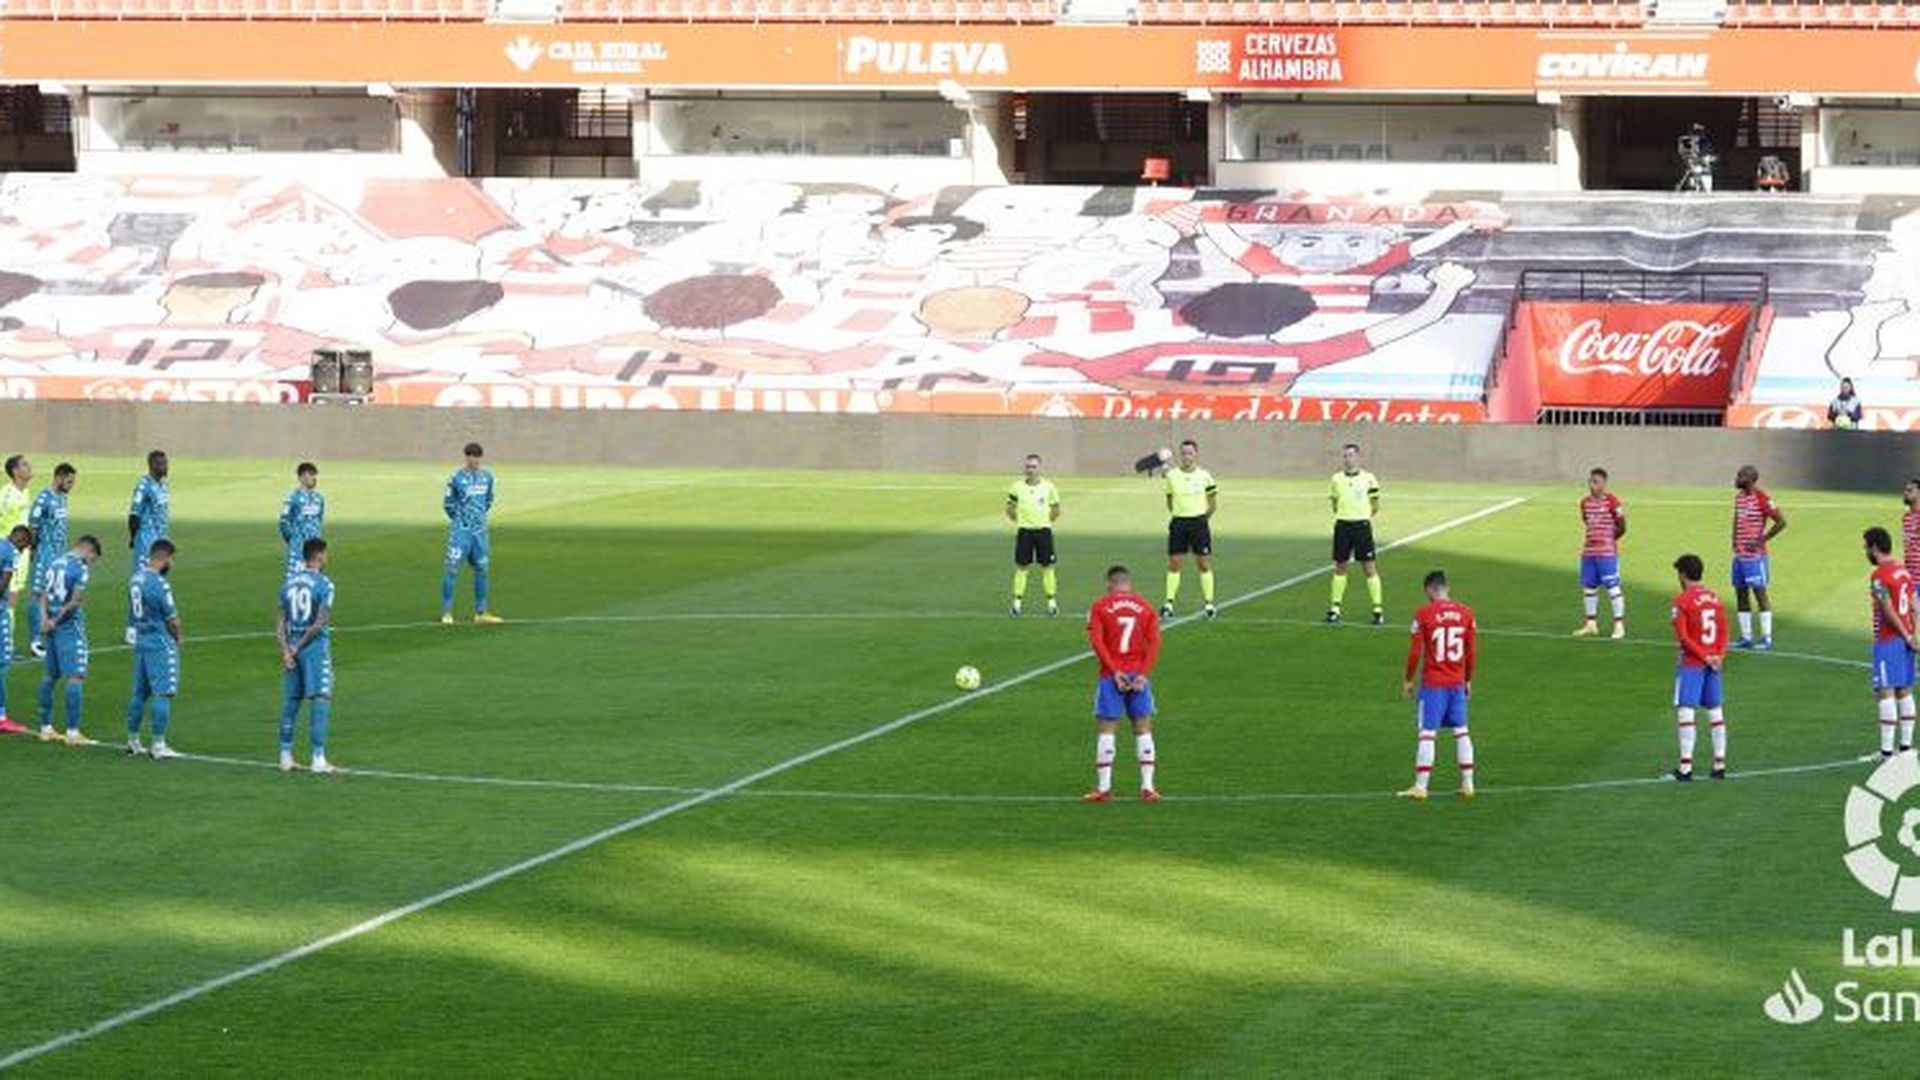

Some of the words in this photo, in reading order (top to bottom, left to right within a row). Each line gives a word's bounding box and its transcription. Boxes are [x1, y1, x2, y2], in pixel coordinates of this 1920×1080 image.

[846, 36, 1008, 73] PULEVA
[1244, 33, 1337, 55] CERVEZAS
[1239, 58, 1344, 80] ALHAMBRA
[1226, 205, 1460, 221] GRANADA
[1560, 319, 1733, 375] Coca-Cola
[131, 585, 143, 619] 8
[288, 586, 312, 621] 19
[1117, 616, 1135, 654] 7
[1432, 626, 1465, 662] 15
[1701, 608, 1717, 645] 5
